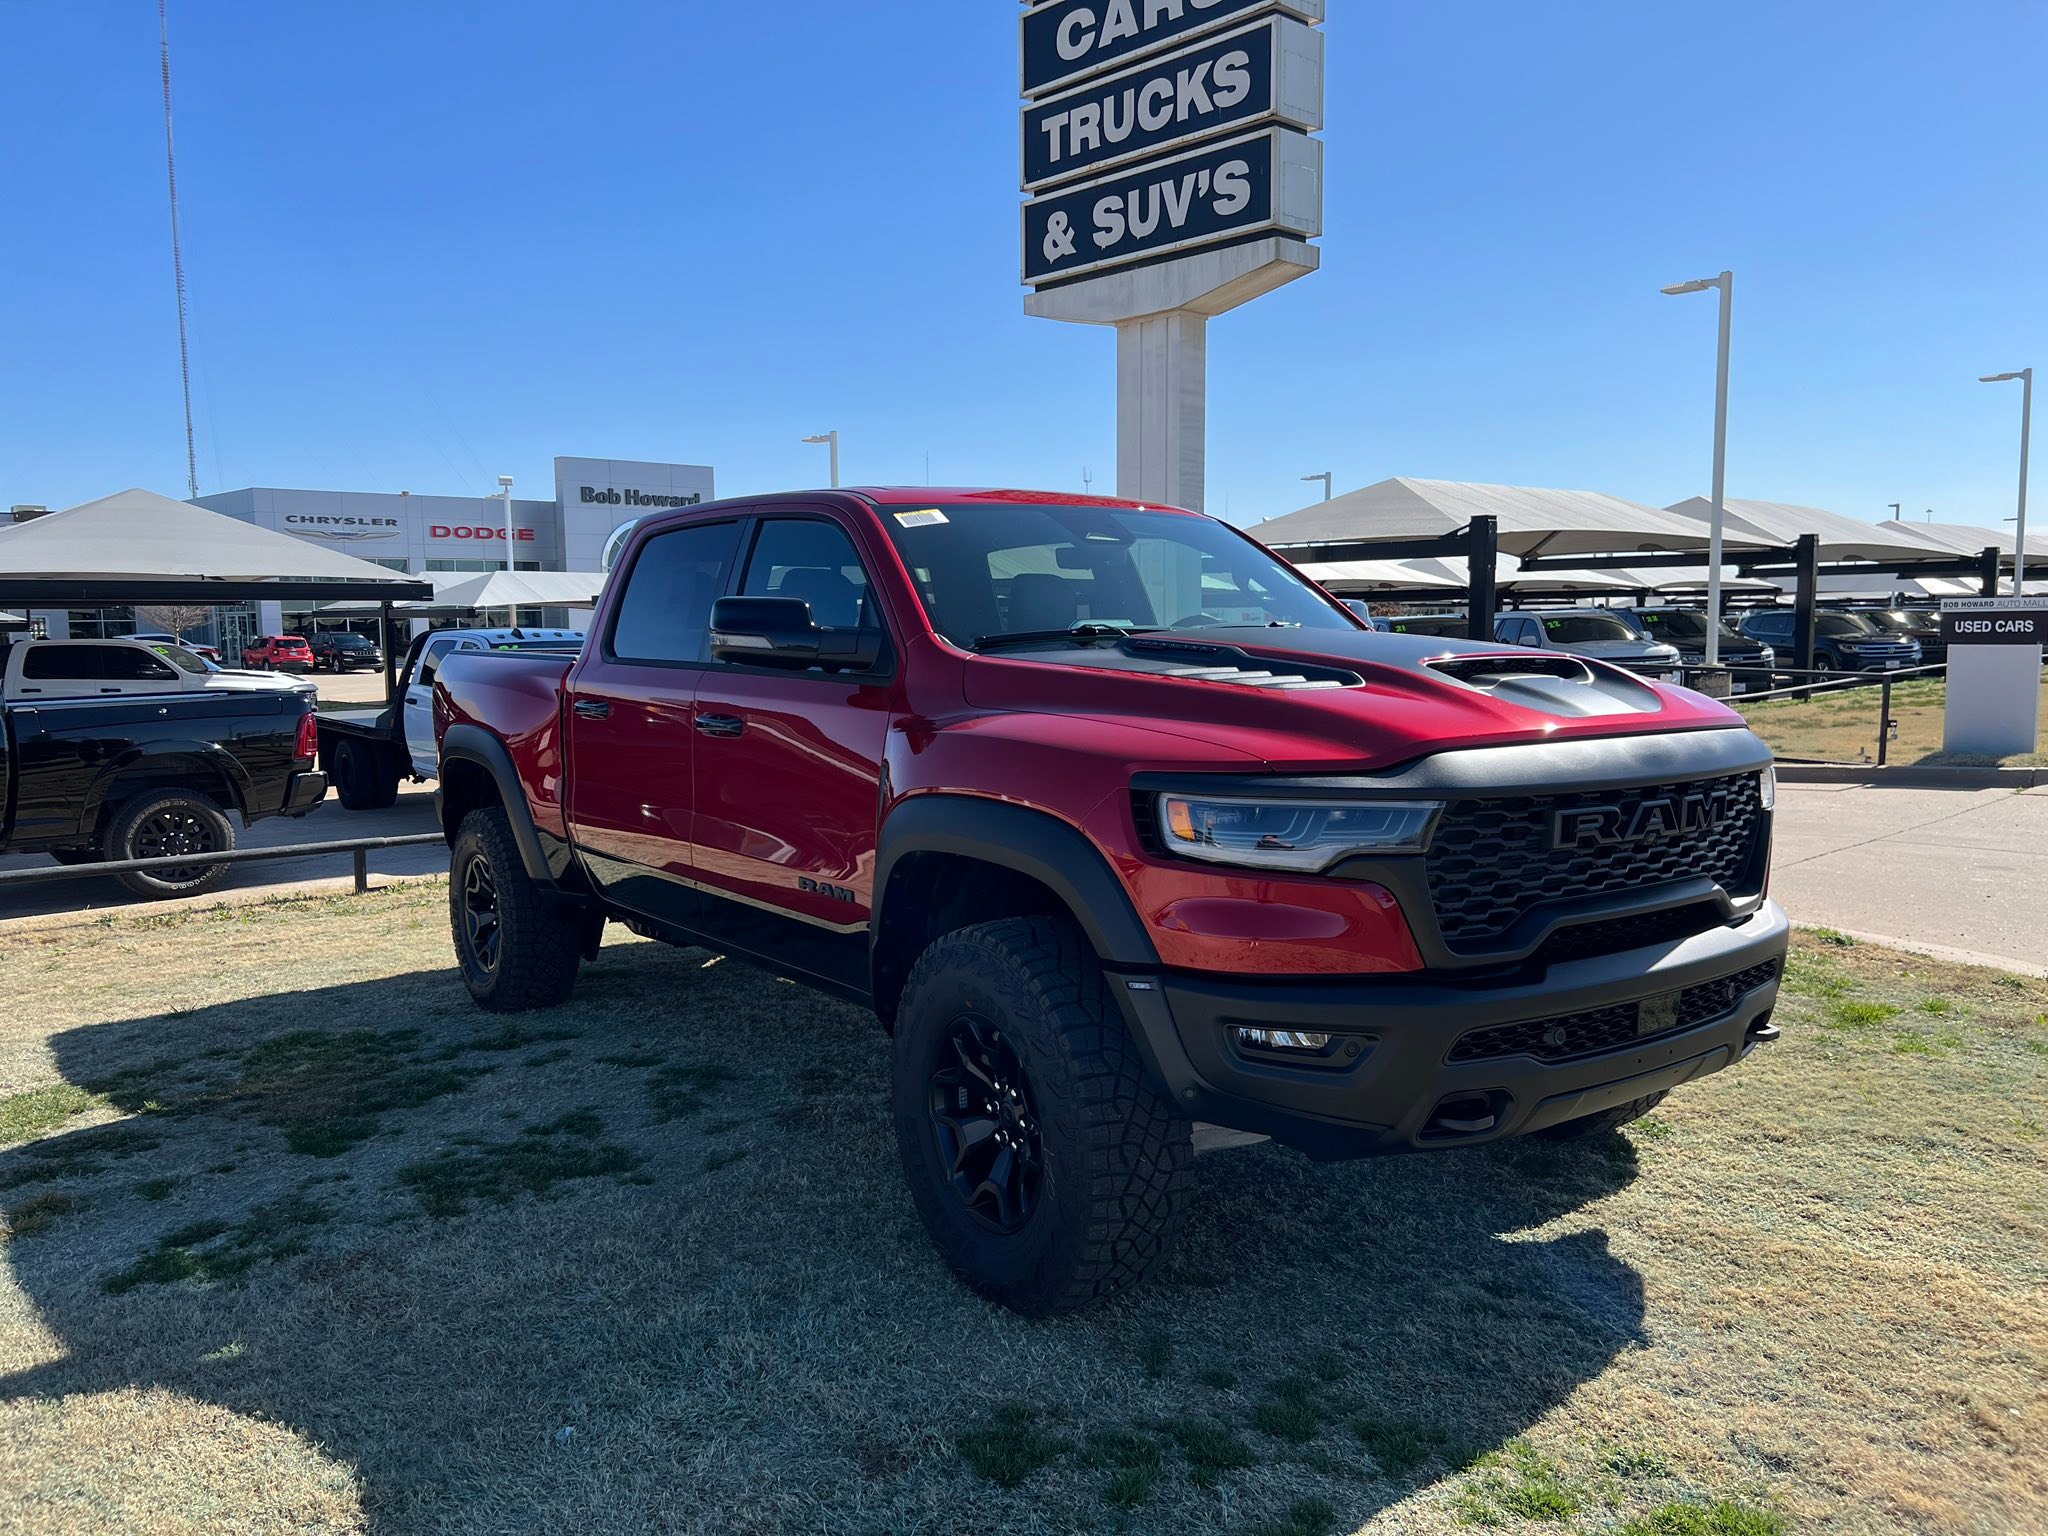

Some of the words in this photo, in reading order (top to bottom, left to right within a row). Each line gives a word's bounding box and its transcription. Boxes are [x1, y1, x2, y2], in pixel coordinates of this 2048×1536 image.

[1056, 0, 1224, 61] CAR
[1041, 50, 1251, 163] TRUCKS
[1043, 210, 1077, 264] &
[1092, 160, 1251, 249] SUV'S
[580, 486, 621, 505] Bob
[625, 488, 701, 508] Howard
[285, 515, 398, 526] CHRYSLER
[430, 525, 535, 541] DODGE
[1395, 624, 1407, 633] 21
[1547, 620, 1561, 629] 22
[1954, 620, 1992, 633] USED
[1995, 620, 2034, 633] CARS
[1553, 790, 1728, 849] RAM
[798, 876, 856, 904] RAM
